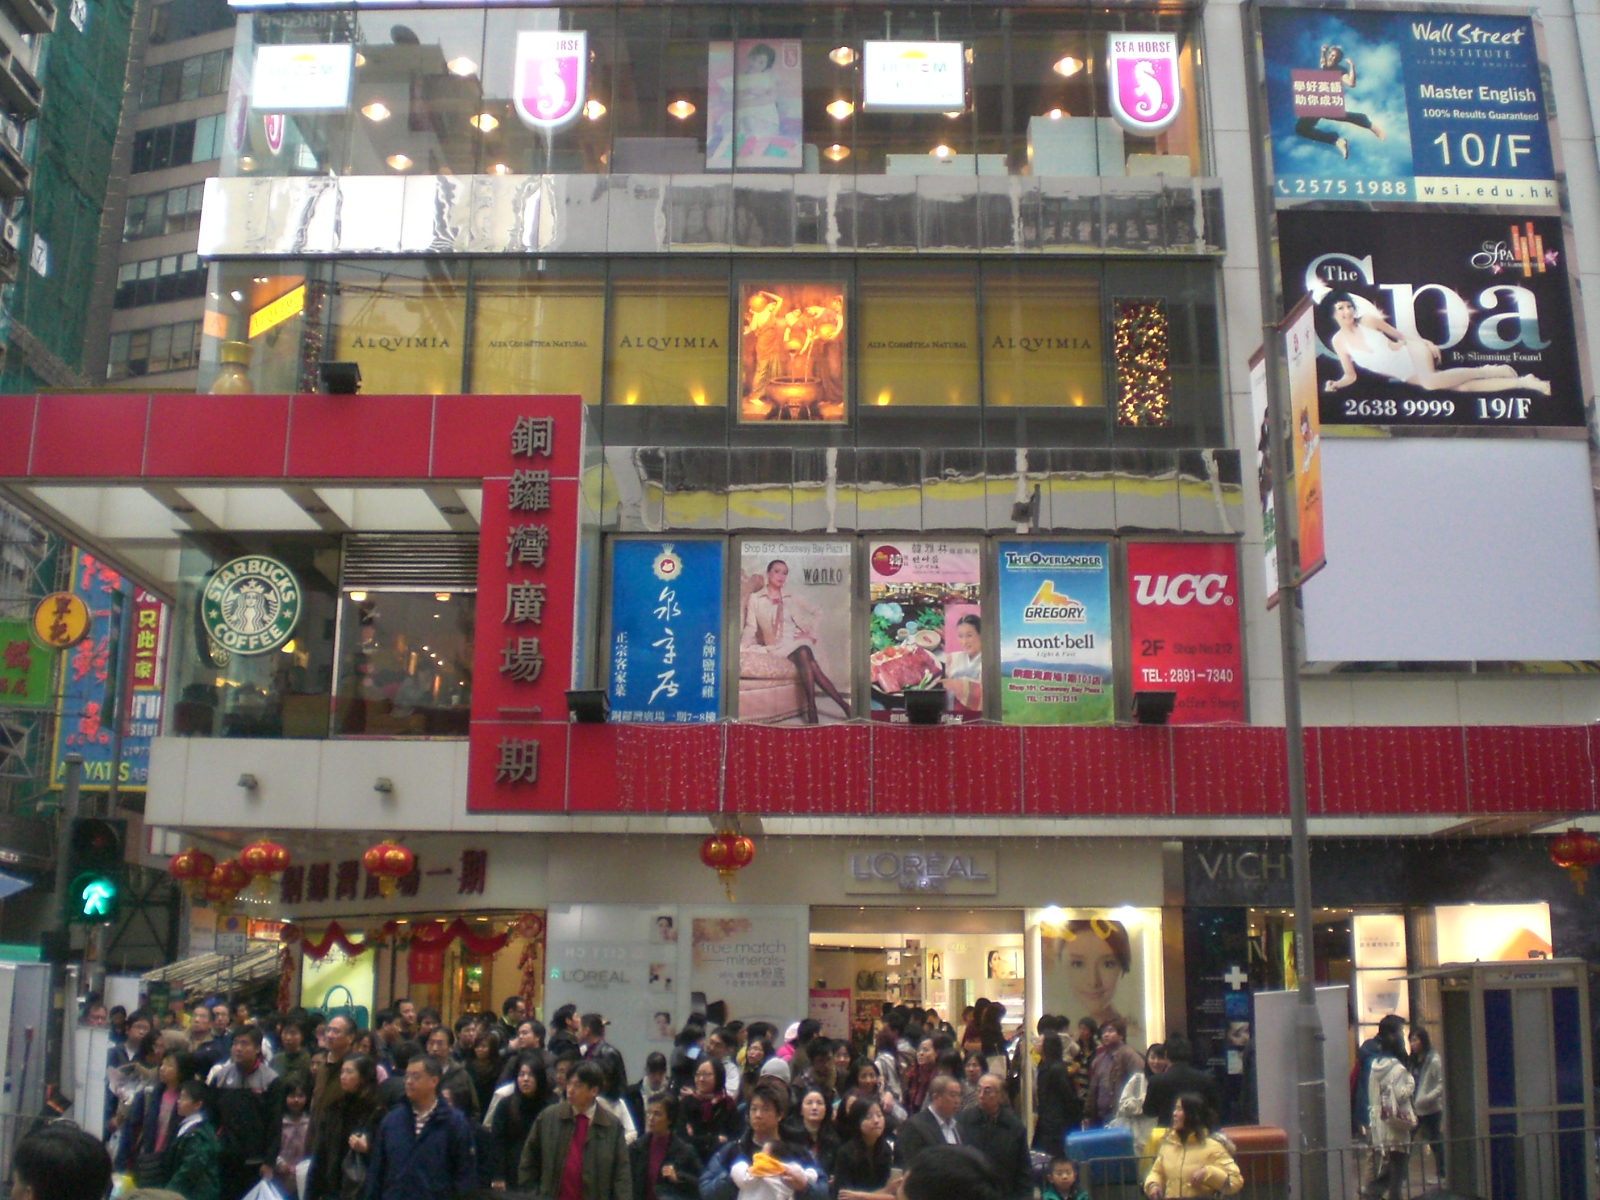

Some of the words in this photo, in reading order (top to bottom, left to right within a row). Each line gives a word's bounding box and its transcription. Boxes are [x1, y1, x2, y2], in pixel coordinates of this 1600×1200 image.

[1412, 21, 1454, 43] Wall
[1457, 23, 1525, 45] Street
[1115, 41, 1135, 53] SEA
[1138, 41, 1171, 53] HORSE
[1430, 47, 1511, 59] INSTITUTE
[1295, 94, 1344, 107] 助你成功
[1420, 84, 1473, 99] Master
[1479, 86, 1536, 104] English
[1423, 108, 1451, 118] 100%
[1453, 109, 1487, 119] Results
[1488, 110, 1539, 121] Guaranteed
[1433, 131, 1531, 168] 10/F
[1296, 179, 1348, 194] 2575
[1355, 180, 1407, 195] 1988
[1324, 265, 1358, 282] The
[352, 335, 450, 351] ALQVIMIA
[619, 335, 719, 351] ALQVIMIA
[992, 335, 1092, 352] ALQVIMIA
[1453, 352, 1465, 363] By
[1468, 352, 1511, 363] Slimming
[1513, 352, 1542, 361] Found
[1345, 398, 1398, 416] 2638
[1403, 399, 1455, 417] 9999
[1478, 397, 1532, 419] 19/F
[1029, 552, 1101, 565] OVERLANDER
[207, 559, 296, 603] STARBUCKS
[803, 568, 843, 584] wanko
[495, 415, 554, 784] 銅鑼灣廣場一期
[1025, 607, 1084, 618] GREGORY
[214, 622, 284, 649] COFFEE
[134, 609, 157, 680] 只此一家
[1141, 639, 1165, 657] 2F
[1198, 851, 1293, 880] VICH
[701, 941, 732, 954] true
[734, 940, 786, 955] match
[725, 955, 780, 966] minerals
